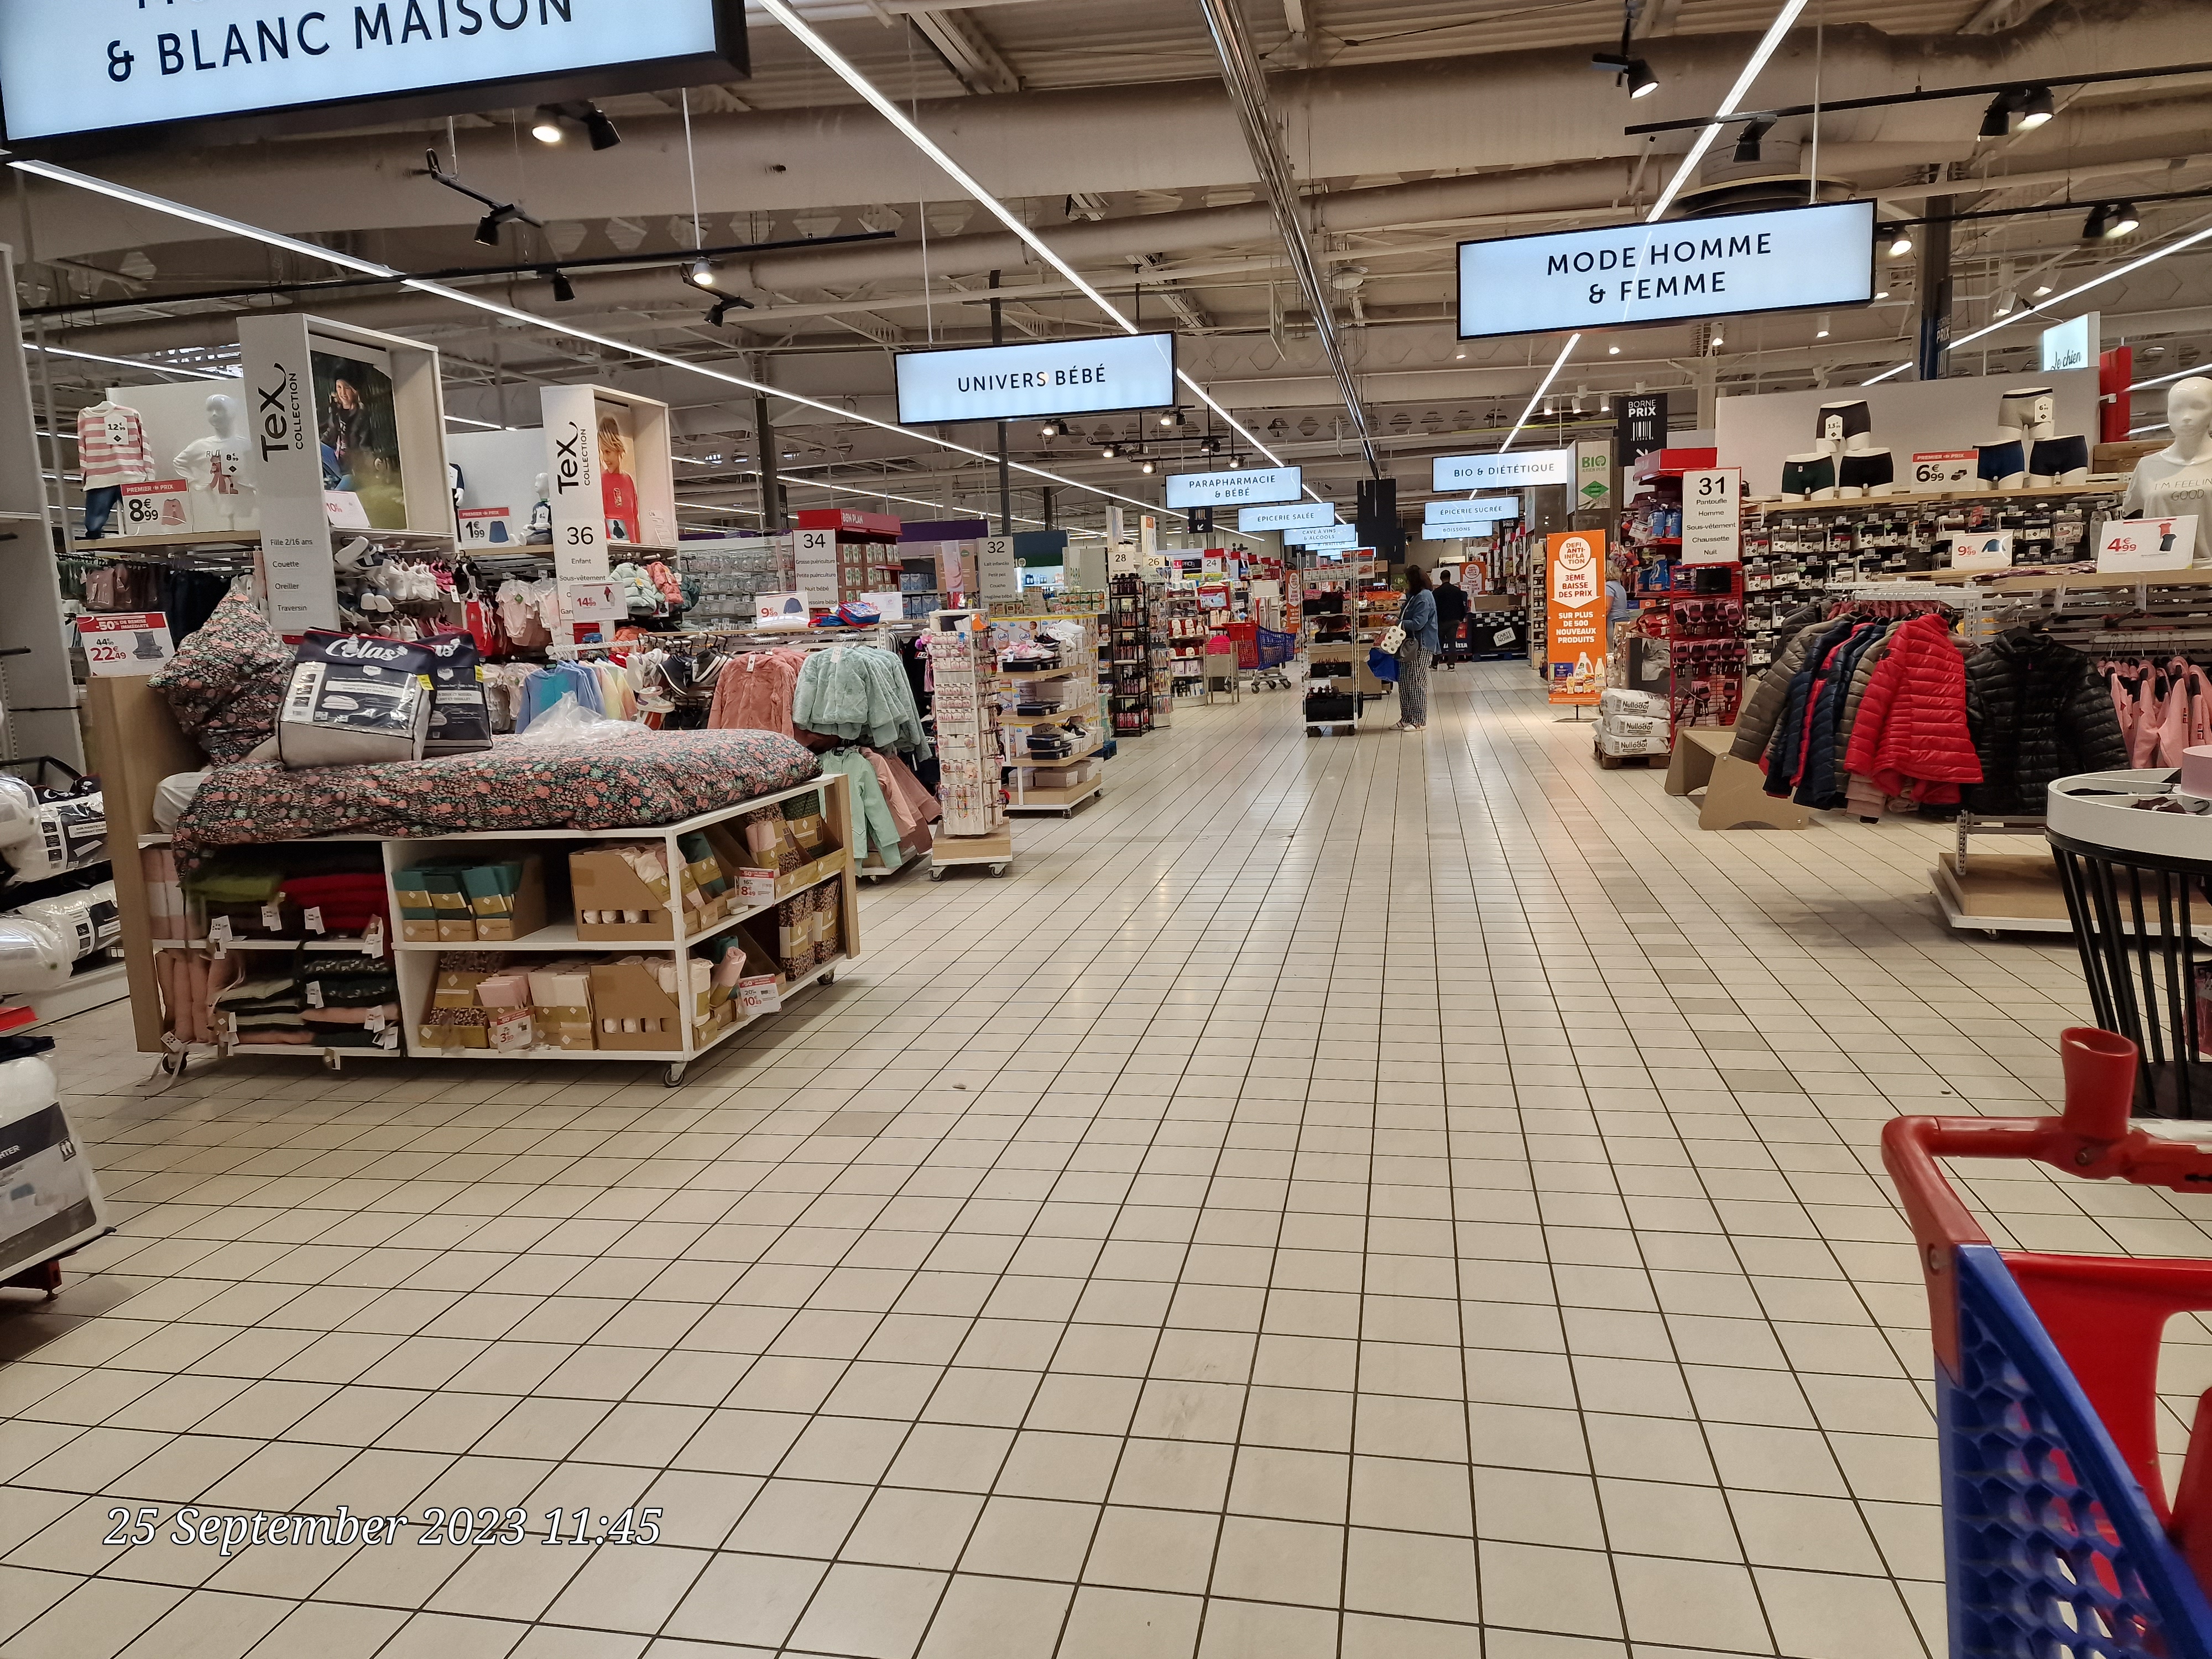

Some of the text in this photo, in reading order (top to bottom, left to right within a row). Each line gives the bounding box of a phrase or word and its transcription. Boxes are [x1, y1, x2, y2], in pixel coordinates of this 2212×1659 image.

[106, 0, 572, 82] & BLANC MAISON
[1547, 232, 1773, 276] MODE HOMME
[1588, 271, 1726, 304] & FEMME
[2063, 349, 2083, 368] chien
[958, 363, 1106, 393] UNIVERS BÉBÉ
[1628, 399, 1657, 409] BORNE
[288, 373, 304, 450] COLLECTION
[1628, 406, 1657, 418] PRIX
[580, 429, 591, 486] COLLECTION
[1582, 455, 1606, 468] BIO
[1454, 468, 1473, 477] BIO
[1488, 463, 1554, 475] DIÉTÉTIQUE
[1189, 475, 1276, 488] PARAPHARMACIE
[1698, 476, 1725, 496] 31
[1225, 487, 1250, 498] BÉBÉ
[2171, 489, 2205, 502] GOOD
[1474, 505, 1503, 514] SUCRÉE
[842, 512, 863, 524] BON PLAN
[1257, 512, 1315, 523] ÉPICERIE SALÉE
[1686, 522, 1736, 530] Sous-vêtement
[567, 526, 594, 545] 36
[803, 533, 826, 549] 34
[987, 541, 1005, 554] 32
[1115, 554, 1126, 562] 28
[1147, 558, 1160, 566] 26
[1070, 567, 1081, 580] PARA
[1565, 572, 1585, 581] 3ÈME
[1562, 581, 1589, 589] BAISSE
[1496, 630, 1511, 639] CARTE
[1556, 627, 1597, 635] NOUVEAUX
[1498, 635, 1514, 643] NOIRE
[1557, 635, 1595, 644] PRODUITS
[1623, 701, 1650, 709] Nullodor
[1626, 722, 1653, 731] Nullodor
